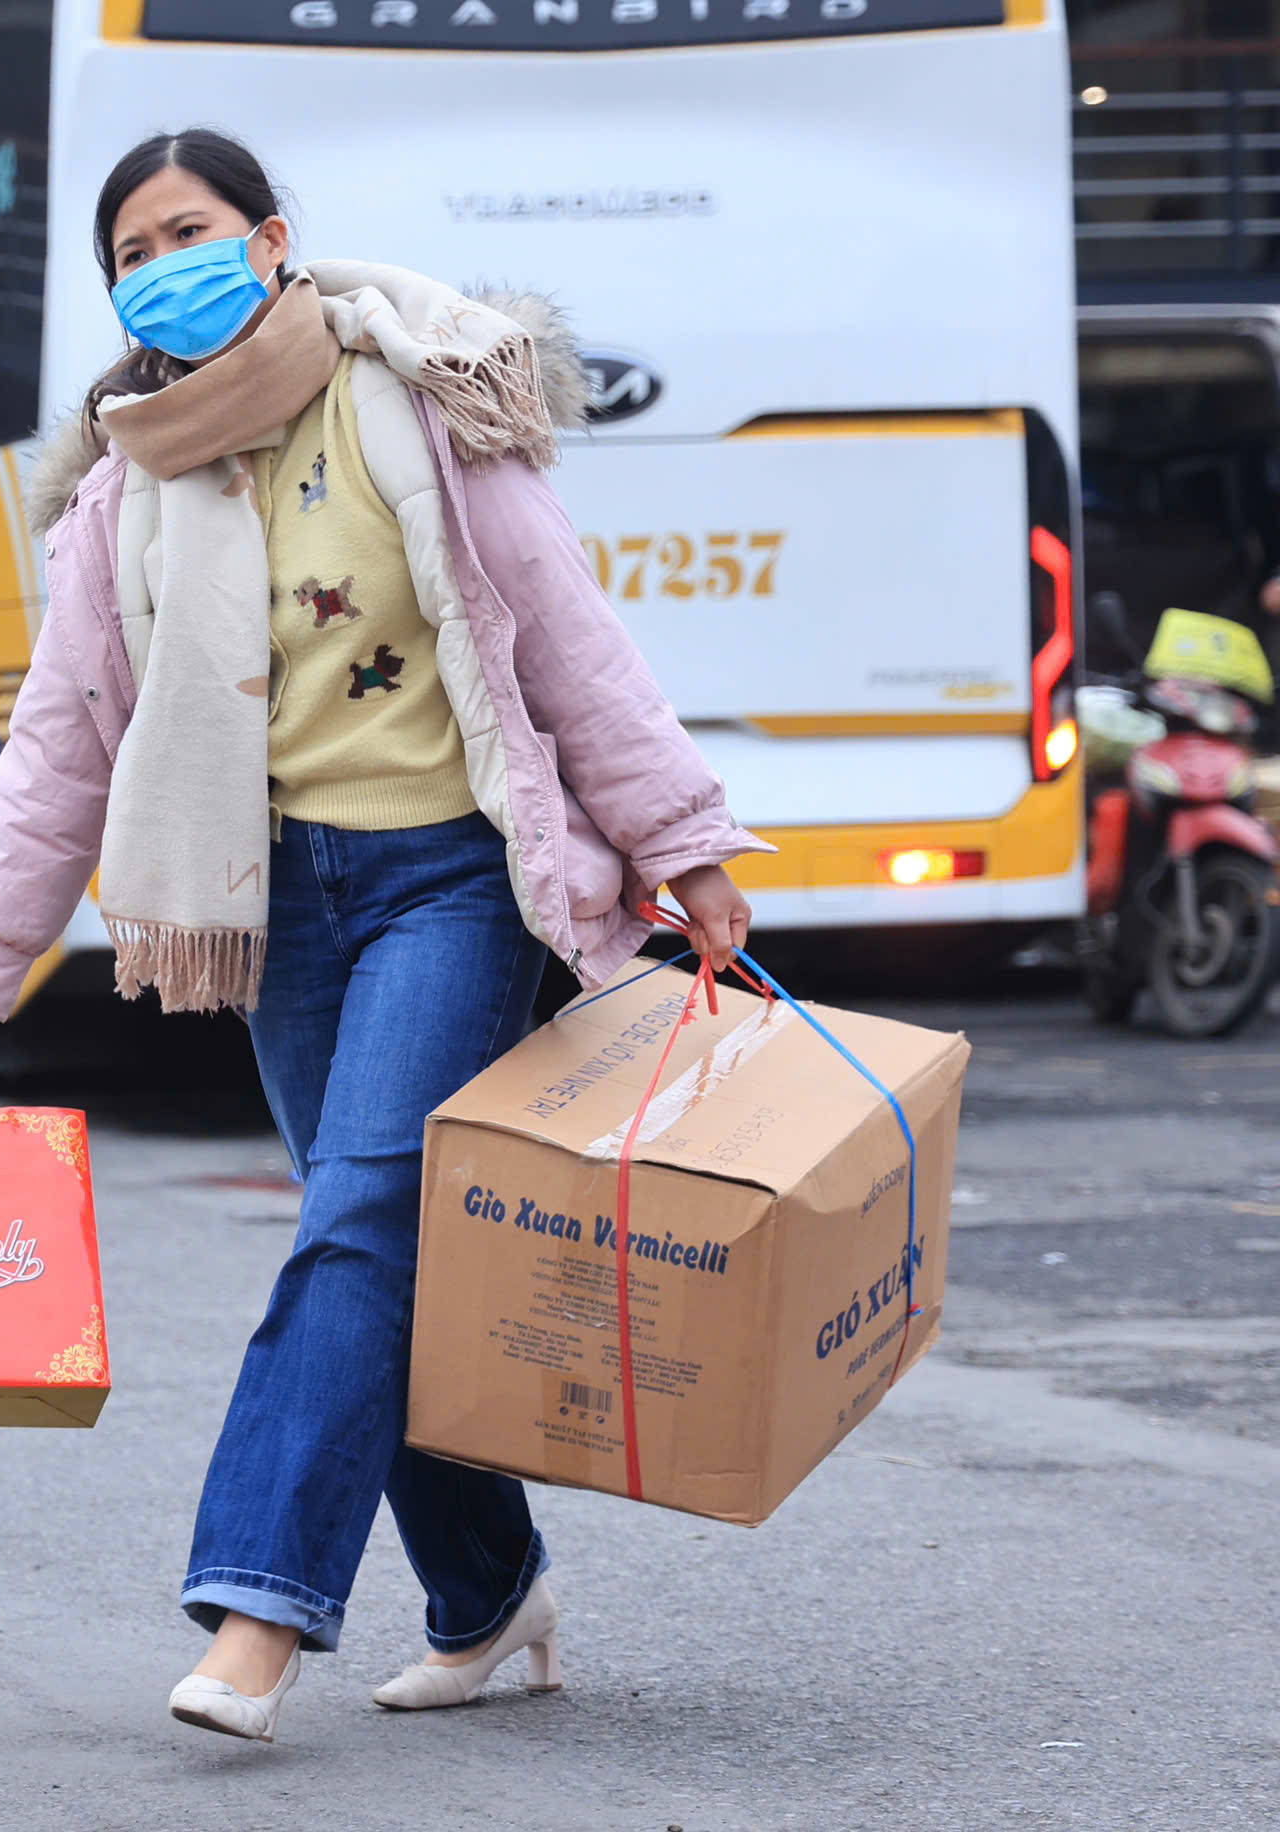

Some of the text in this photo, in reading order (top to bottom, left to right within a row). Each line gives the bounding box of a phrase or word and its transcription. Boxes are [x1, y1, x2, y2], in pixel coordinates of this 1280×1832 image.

[290, 0, 868, 28] GRANBIRD
[576, 1056, 619, 1079] XIN
[523, 1096, 568, 1119] TAY
[464, 1185, 730, 1275] Gio Xuan Vermicelli
[815, 1290, 862, 1360] GIÓ
